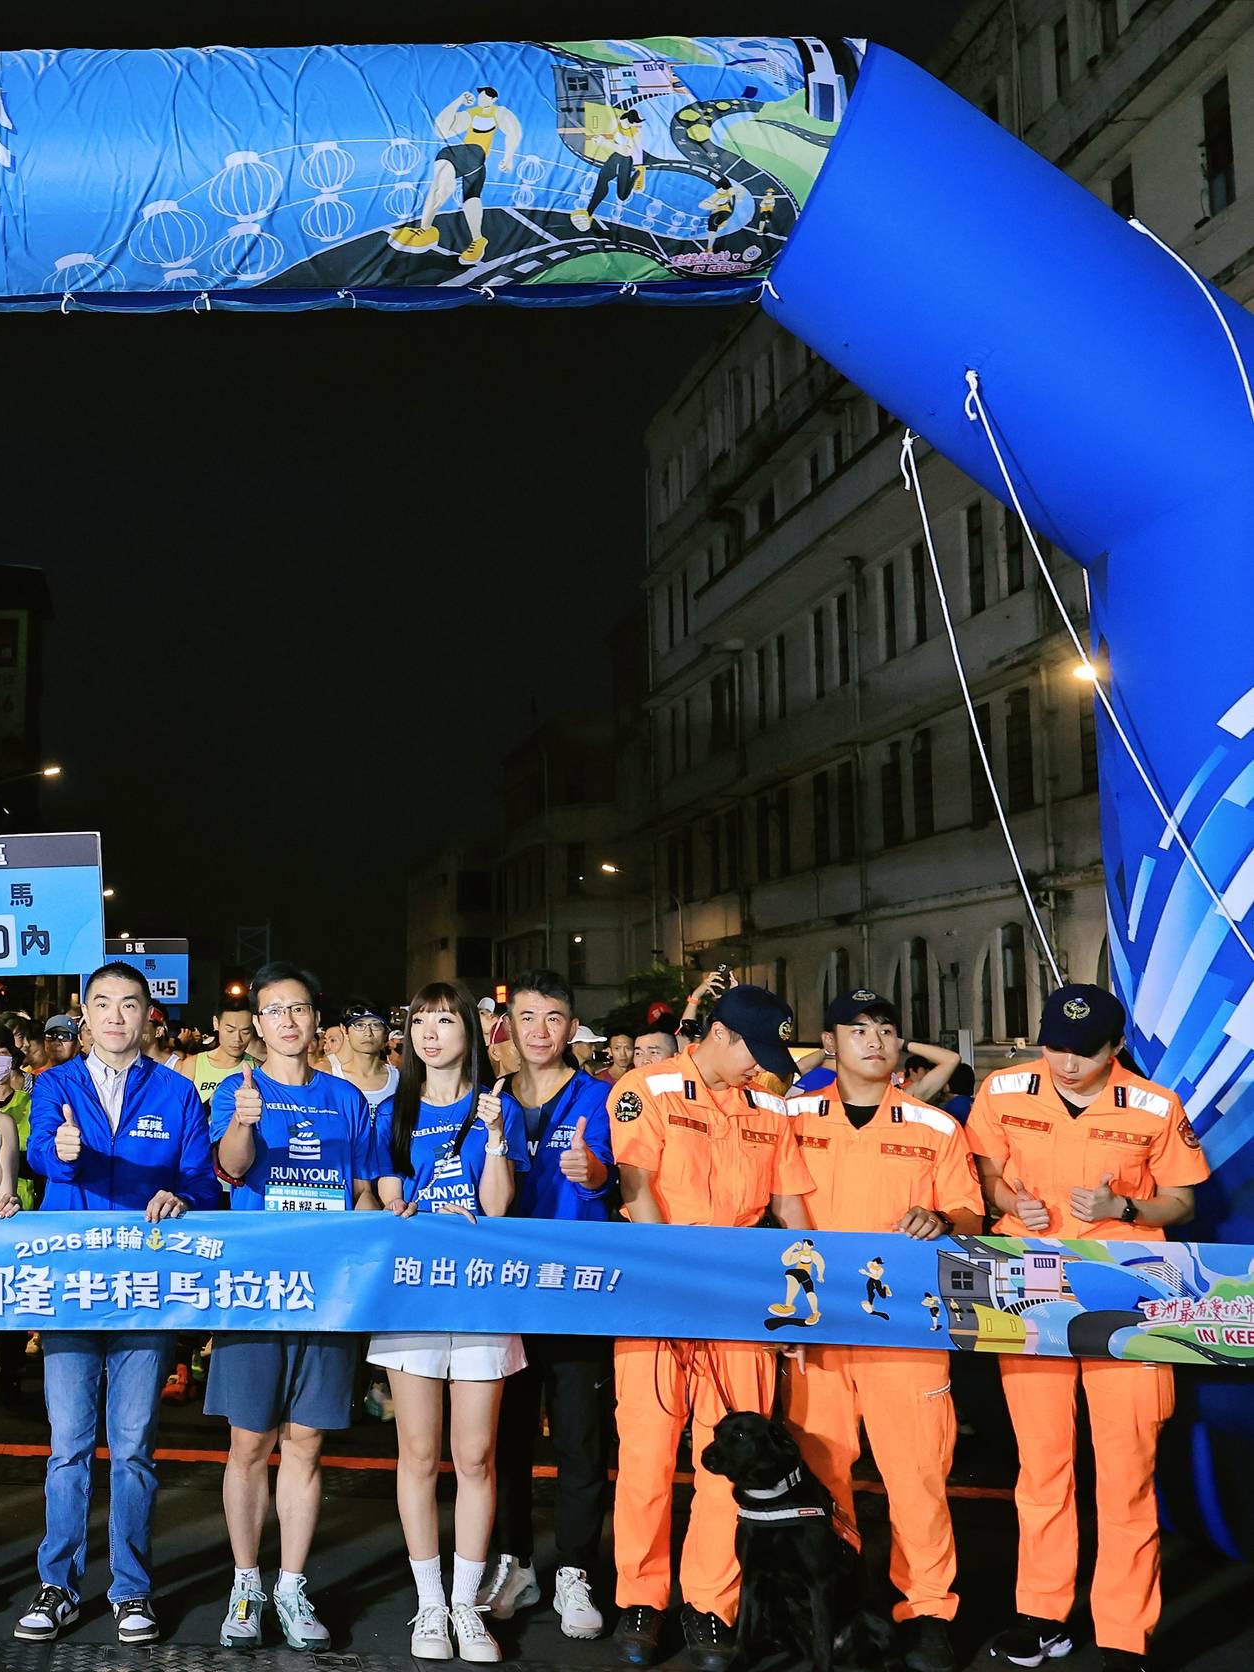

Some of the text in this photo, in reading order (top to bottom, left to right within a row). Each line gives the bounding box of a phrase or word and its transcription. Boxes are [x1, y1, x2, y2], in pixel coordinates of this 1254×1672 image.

[270, 1166, 339, 1183] RUN YOUR
[393, 1256, 622, 1292] 跑出你的畫面!
[1197, 1328, 1217, 1344] IN
